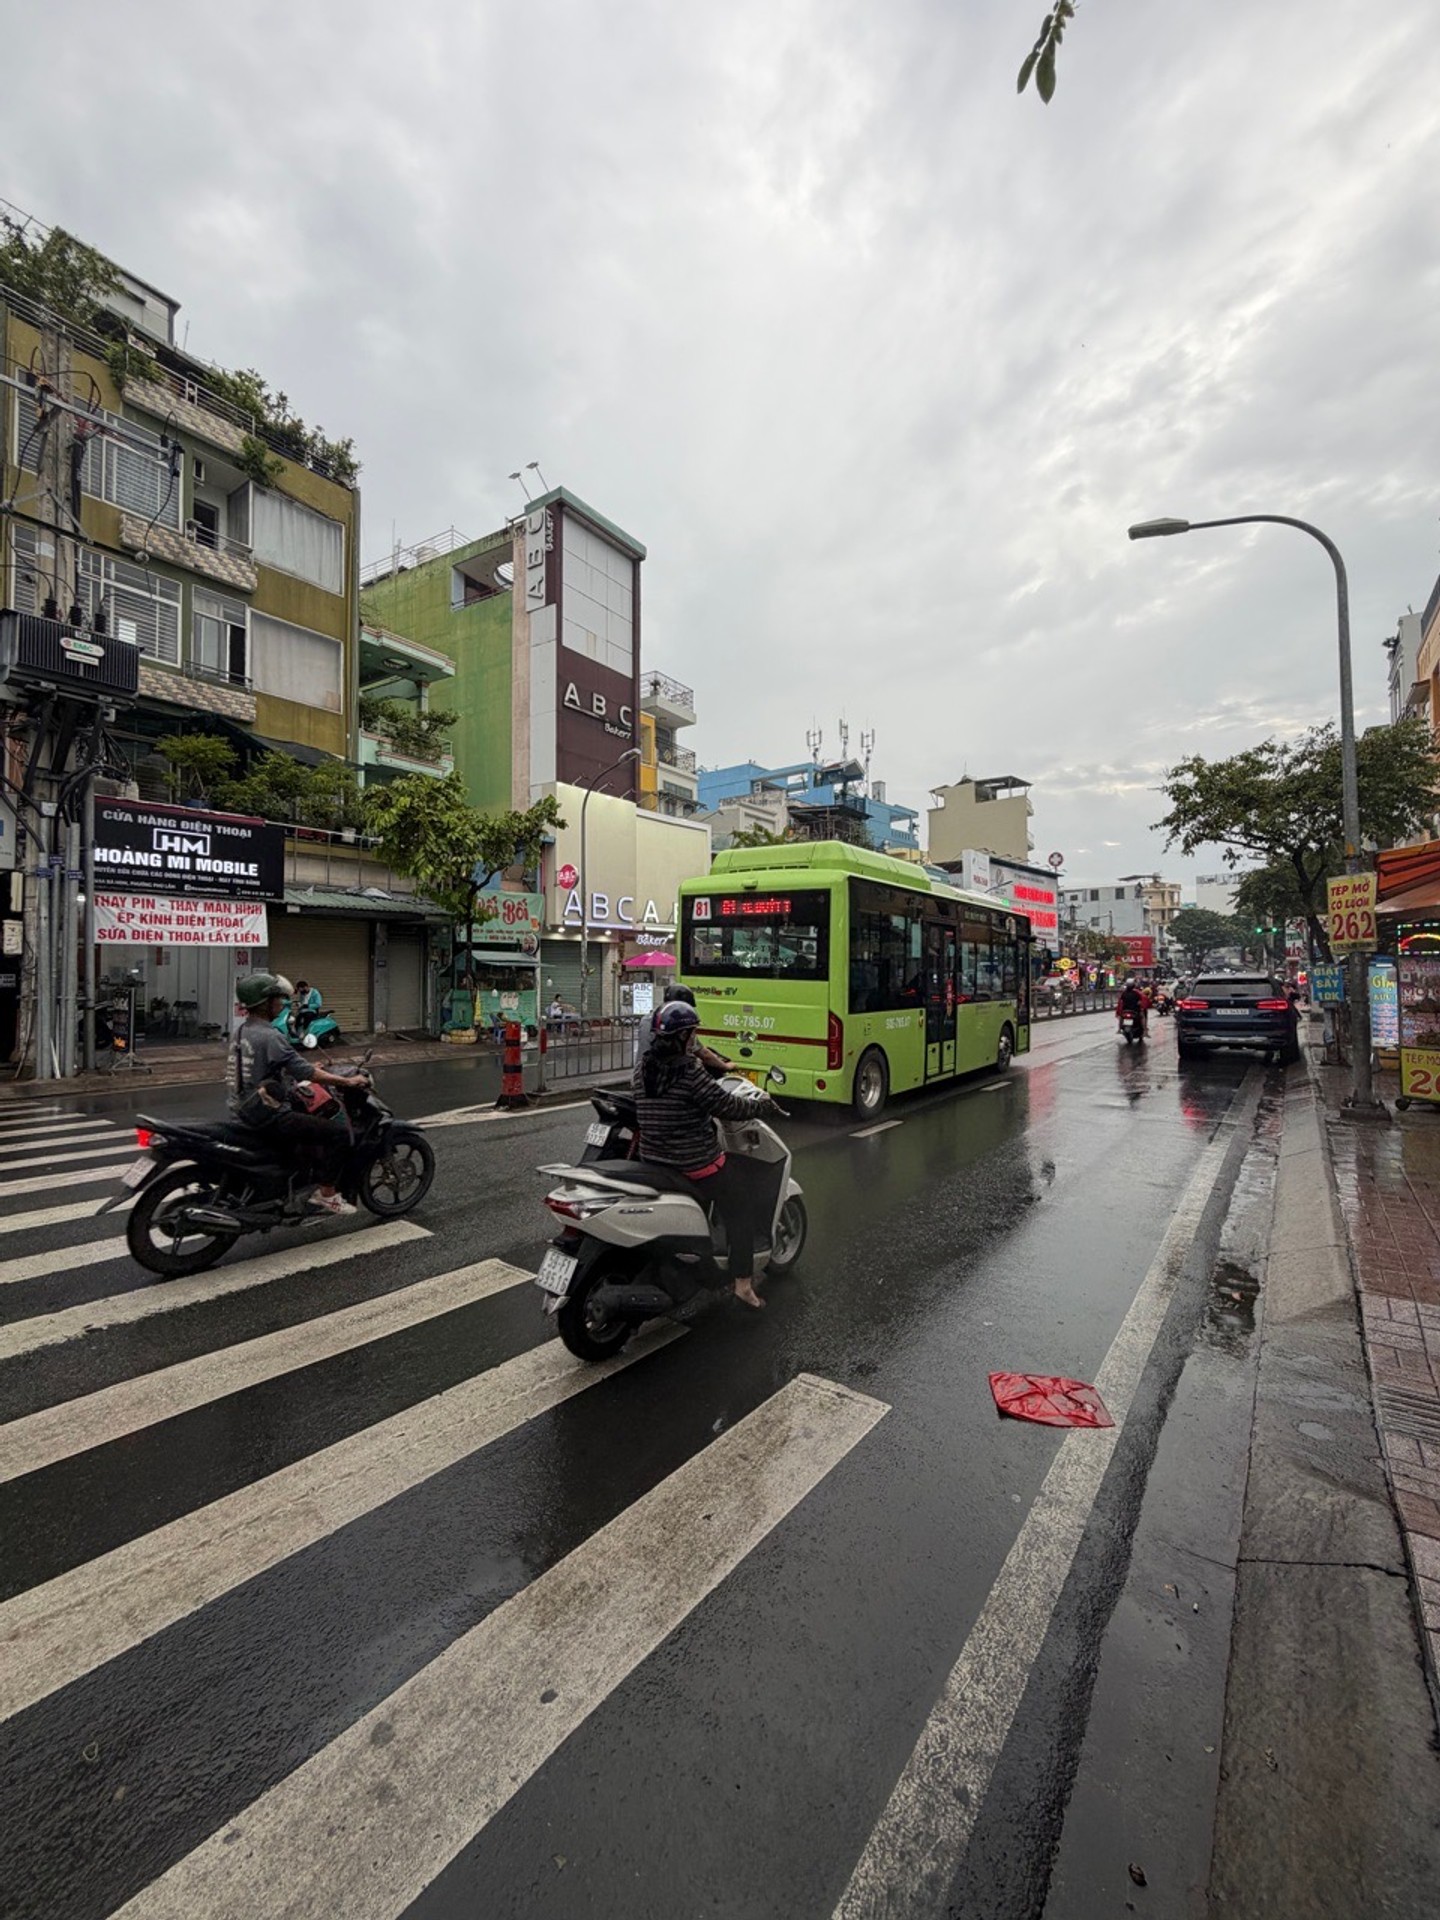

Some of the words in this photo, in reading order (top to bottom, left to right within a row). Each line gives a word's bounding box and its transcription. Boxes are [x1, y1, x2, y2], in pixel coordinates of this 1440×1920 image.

[564, 682, 632, 726] ABC
[137, 814, 177, 829] HÀNG
[95, 845, 162, 868] HOÀNG
[167, 858, 190, 871] MI
[196, 860, 259, 877] MOBILE
[94, 894, 127, 909] THAY
[132, 897, 155, 910] PIN
[170, 900, 199, 912] THAY
[695, 901, 709, 917] 81
[1332, 911, 1374, 941] 262
